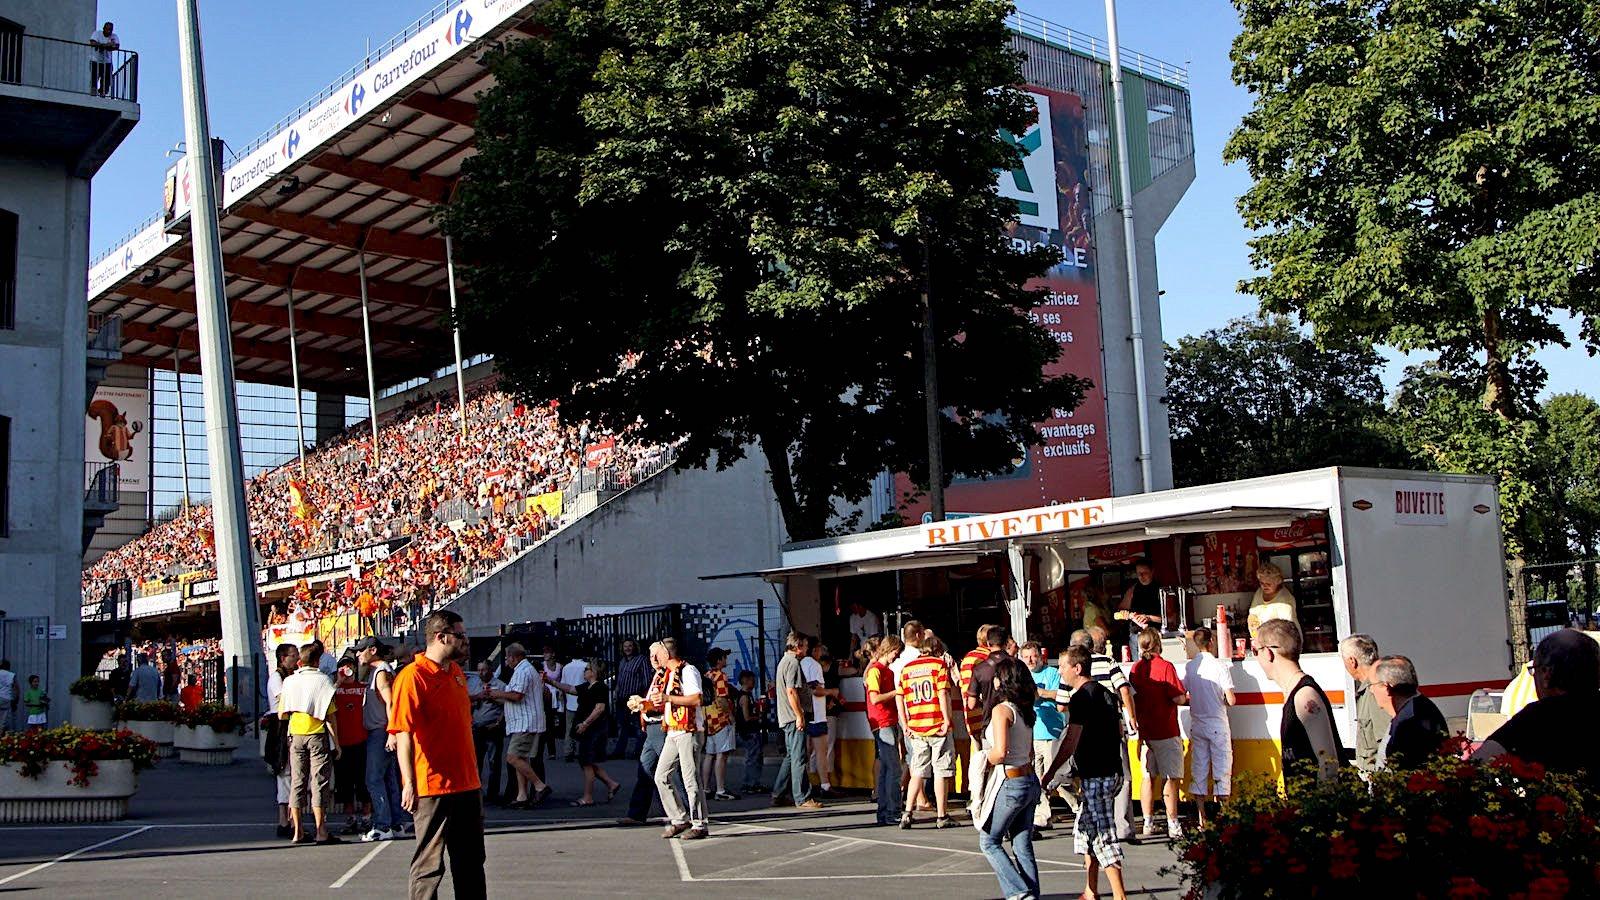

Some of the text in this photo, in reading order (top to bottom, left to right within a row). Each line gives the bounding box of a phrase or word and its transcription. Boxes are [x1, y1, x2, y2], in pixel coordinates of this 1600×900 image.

[373, 36, 439, 94] Carrefour
[230, 150, 278, 193] Carrefour
[1042, 312, 1061, 325] ses
[1041, 423, 1096, 439] avantages
[1043, 440, 1091, 457] exclusifs
[1395, 490, 1444, 515] BUVETTE
[927, 505, 1105, 545] BUVETTE
[321, 556, 333, 572] LES
[910, 680, 933, 704] 10
